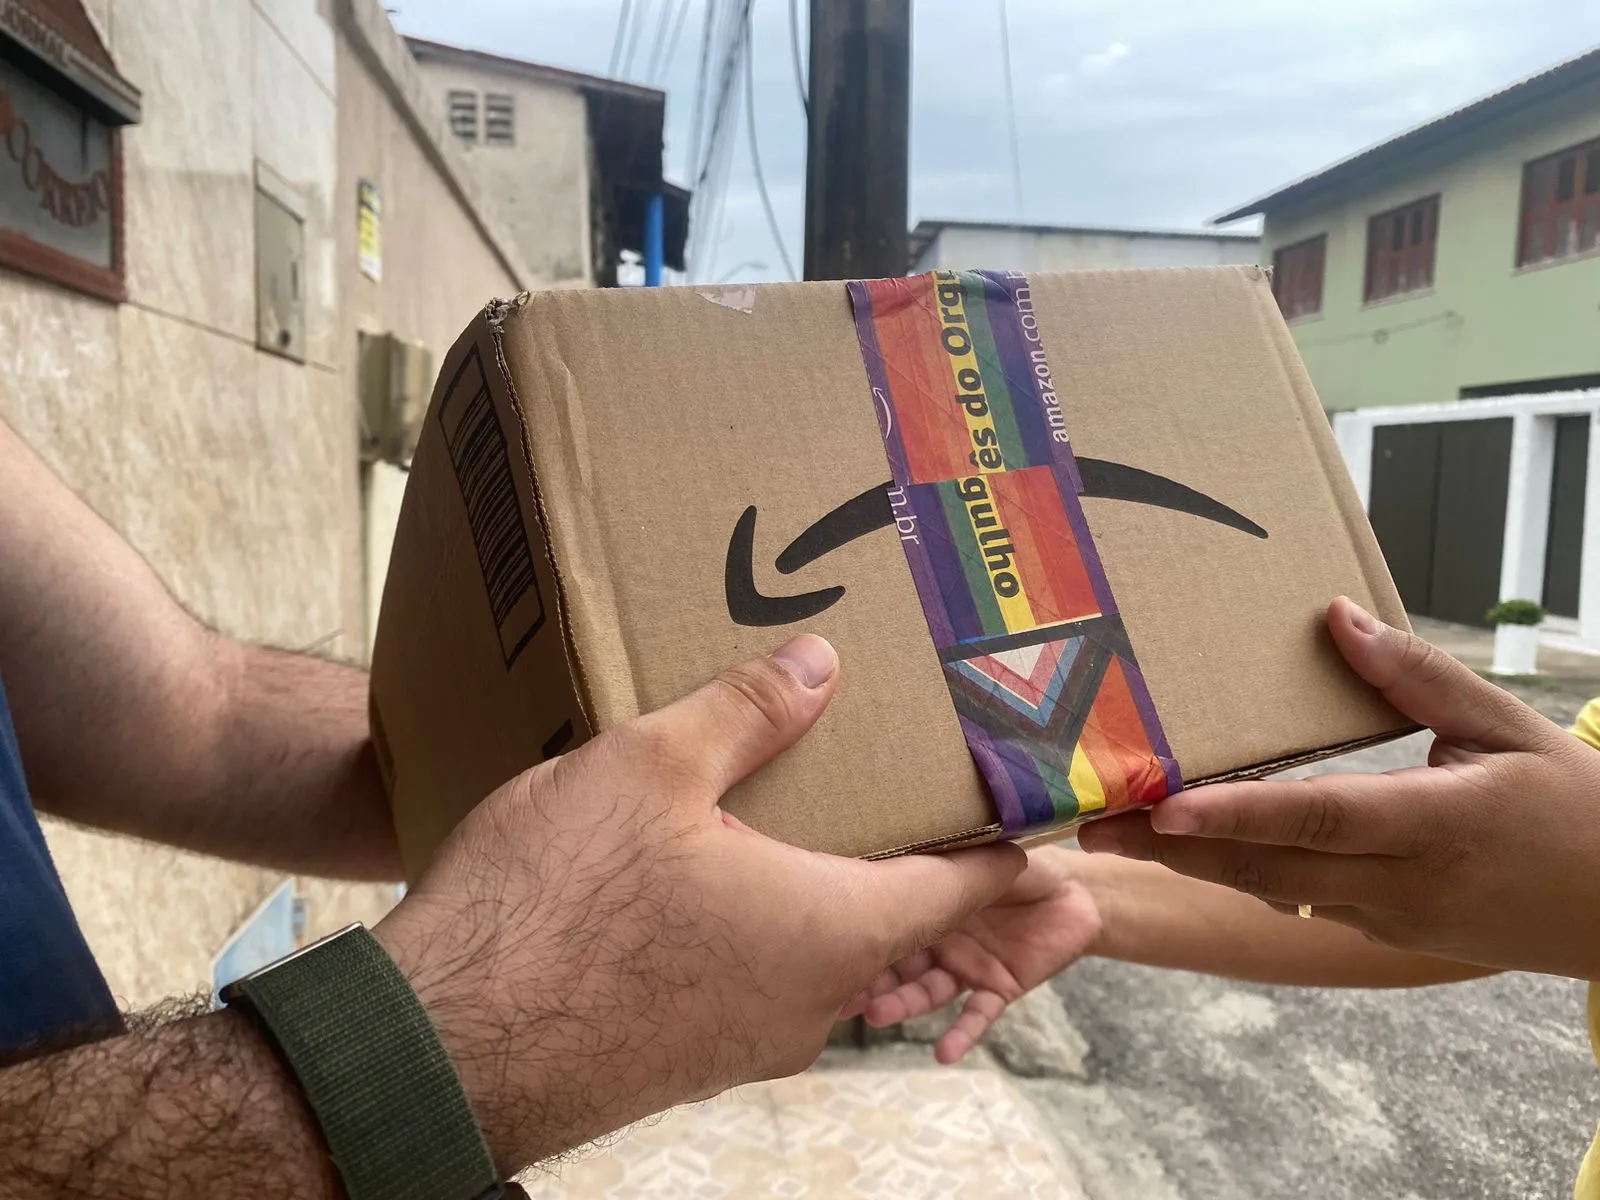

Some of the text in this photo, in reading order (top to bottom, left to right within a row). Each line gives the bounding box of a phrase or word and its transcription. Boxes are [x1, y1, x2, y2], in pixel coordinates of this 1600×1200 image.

[955, 368, 989, 417] do
[969, 426, 1003, 470] ês
[956, 477, 1020, 598] gulho
